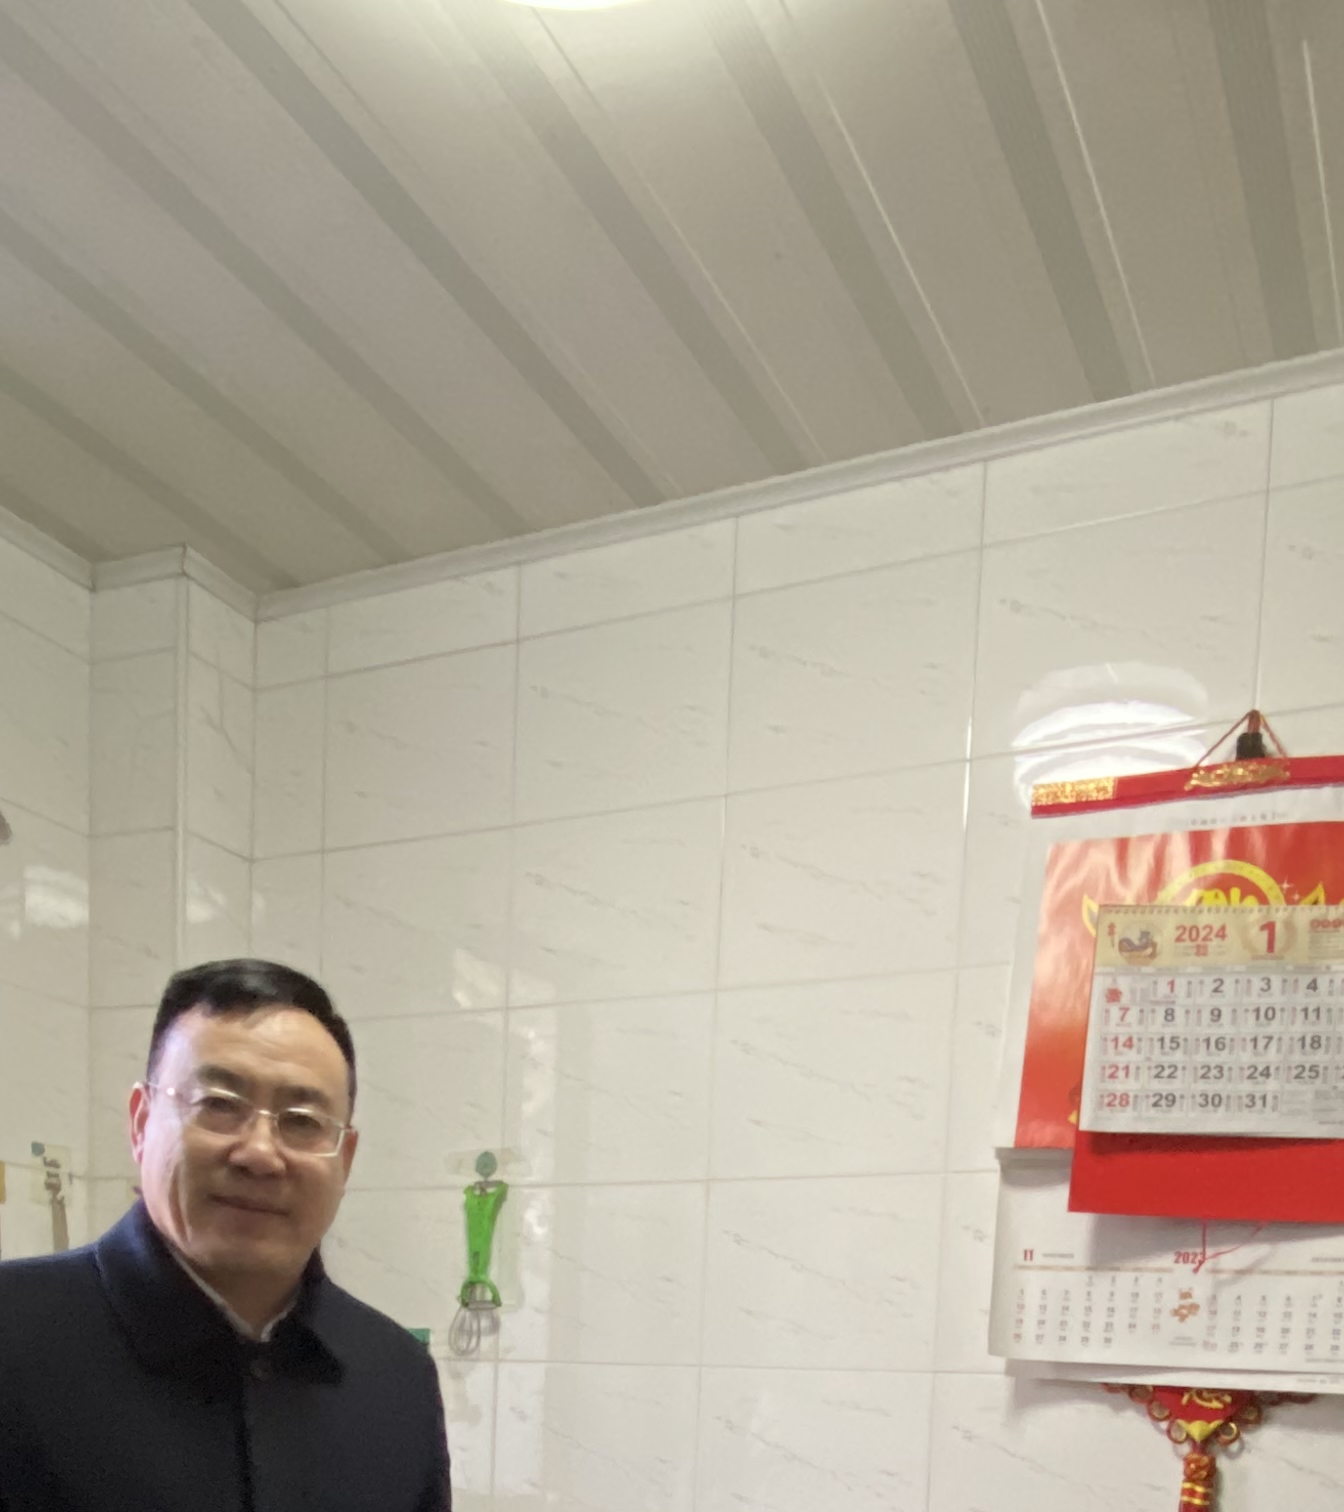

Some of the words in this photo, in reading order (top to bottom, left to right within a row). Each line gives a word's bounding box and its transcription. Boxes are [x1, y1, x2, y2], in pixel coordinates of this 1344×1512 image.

[1174, 923, 1228, 943] 2024
[1259, 921, 1276, 953] 1
[1167, 979, 1176, 994] 1
[1211, 978, 1224, 993] 2
[1260, 977, 1271, 992] 3
[1306, 977, 1318, 992] 4
[1118, 1007, 1130, 1022] 7
[1164, 1008, 1175, 1022] 8
[1210, 1008, 1222, 1023] 9
[1253, 1006, 1276, 1021] 10
[1300, 1006, 1321, 1021] 11
[1111, 1036, 1134, 1050] 14
[1157, 1036, 1180, 1050] 15
[1203, 1036, 1226, 1051] 16
[1250, 1036, 1273, 1050] 17
[1298, 1035, 1321, 1050] 18
[1107, 1064, 1130, 1079] 21
[1154, 1064, 1178, 1079] 22
[1200, 1064, 1224, 1080] 23
[1246, 1065, 1271, 1080] 24
[1294, 1064, 1320, 1080] 25
[1106, 1093, 1130, 1108] 28
[1152, 1093, 1176, 1108] 29
[1198, 1093, 1222, 1108] 30
[1245, 1094, 1267, 1109] 31
